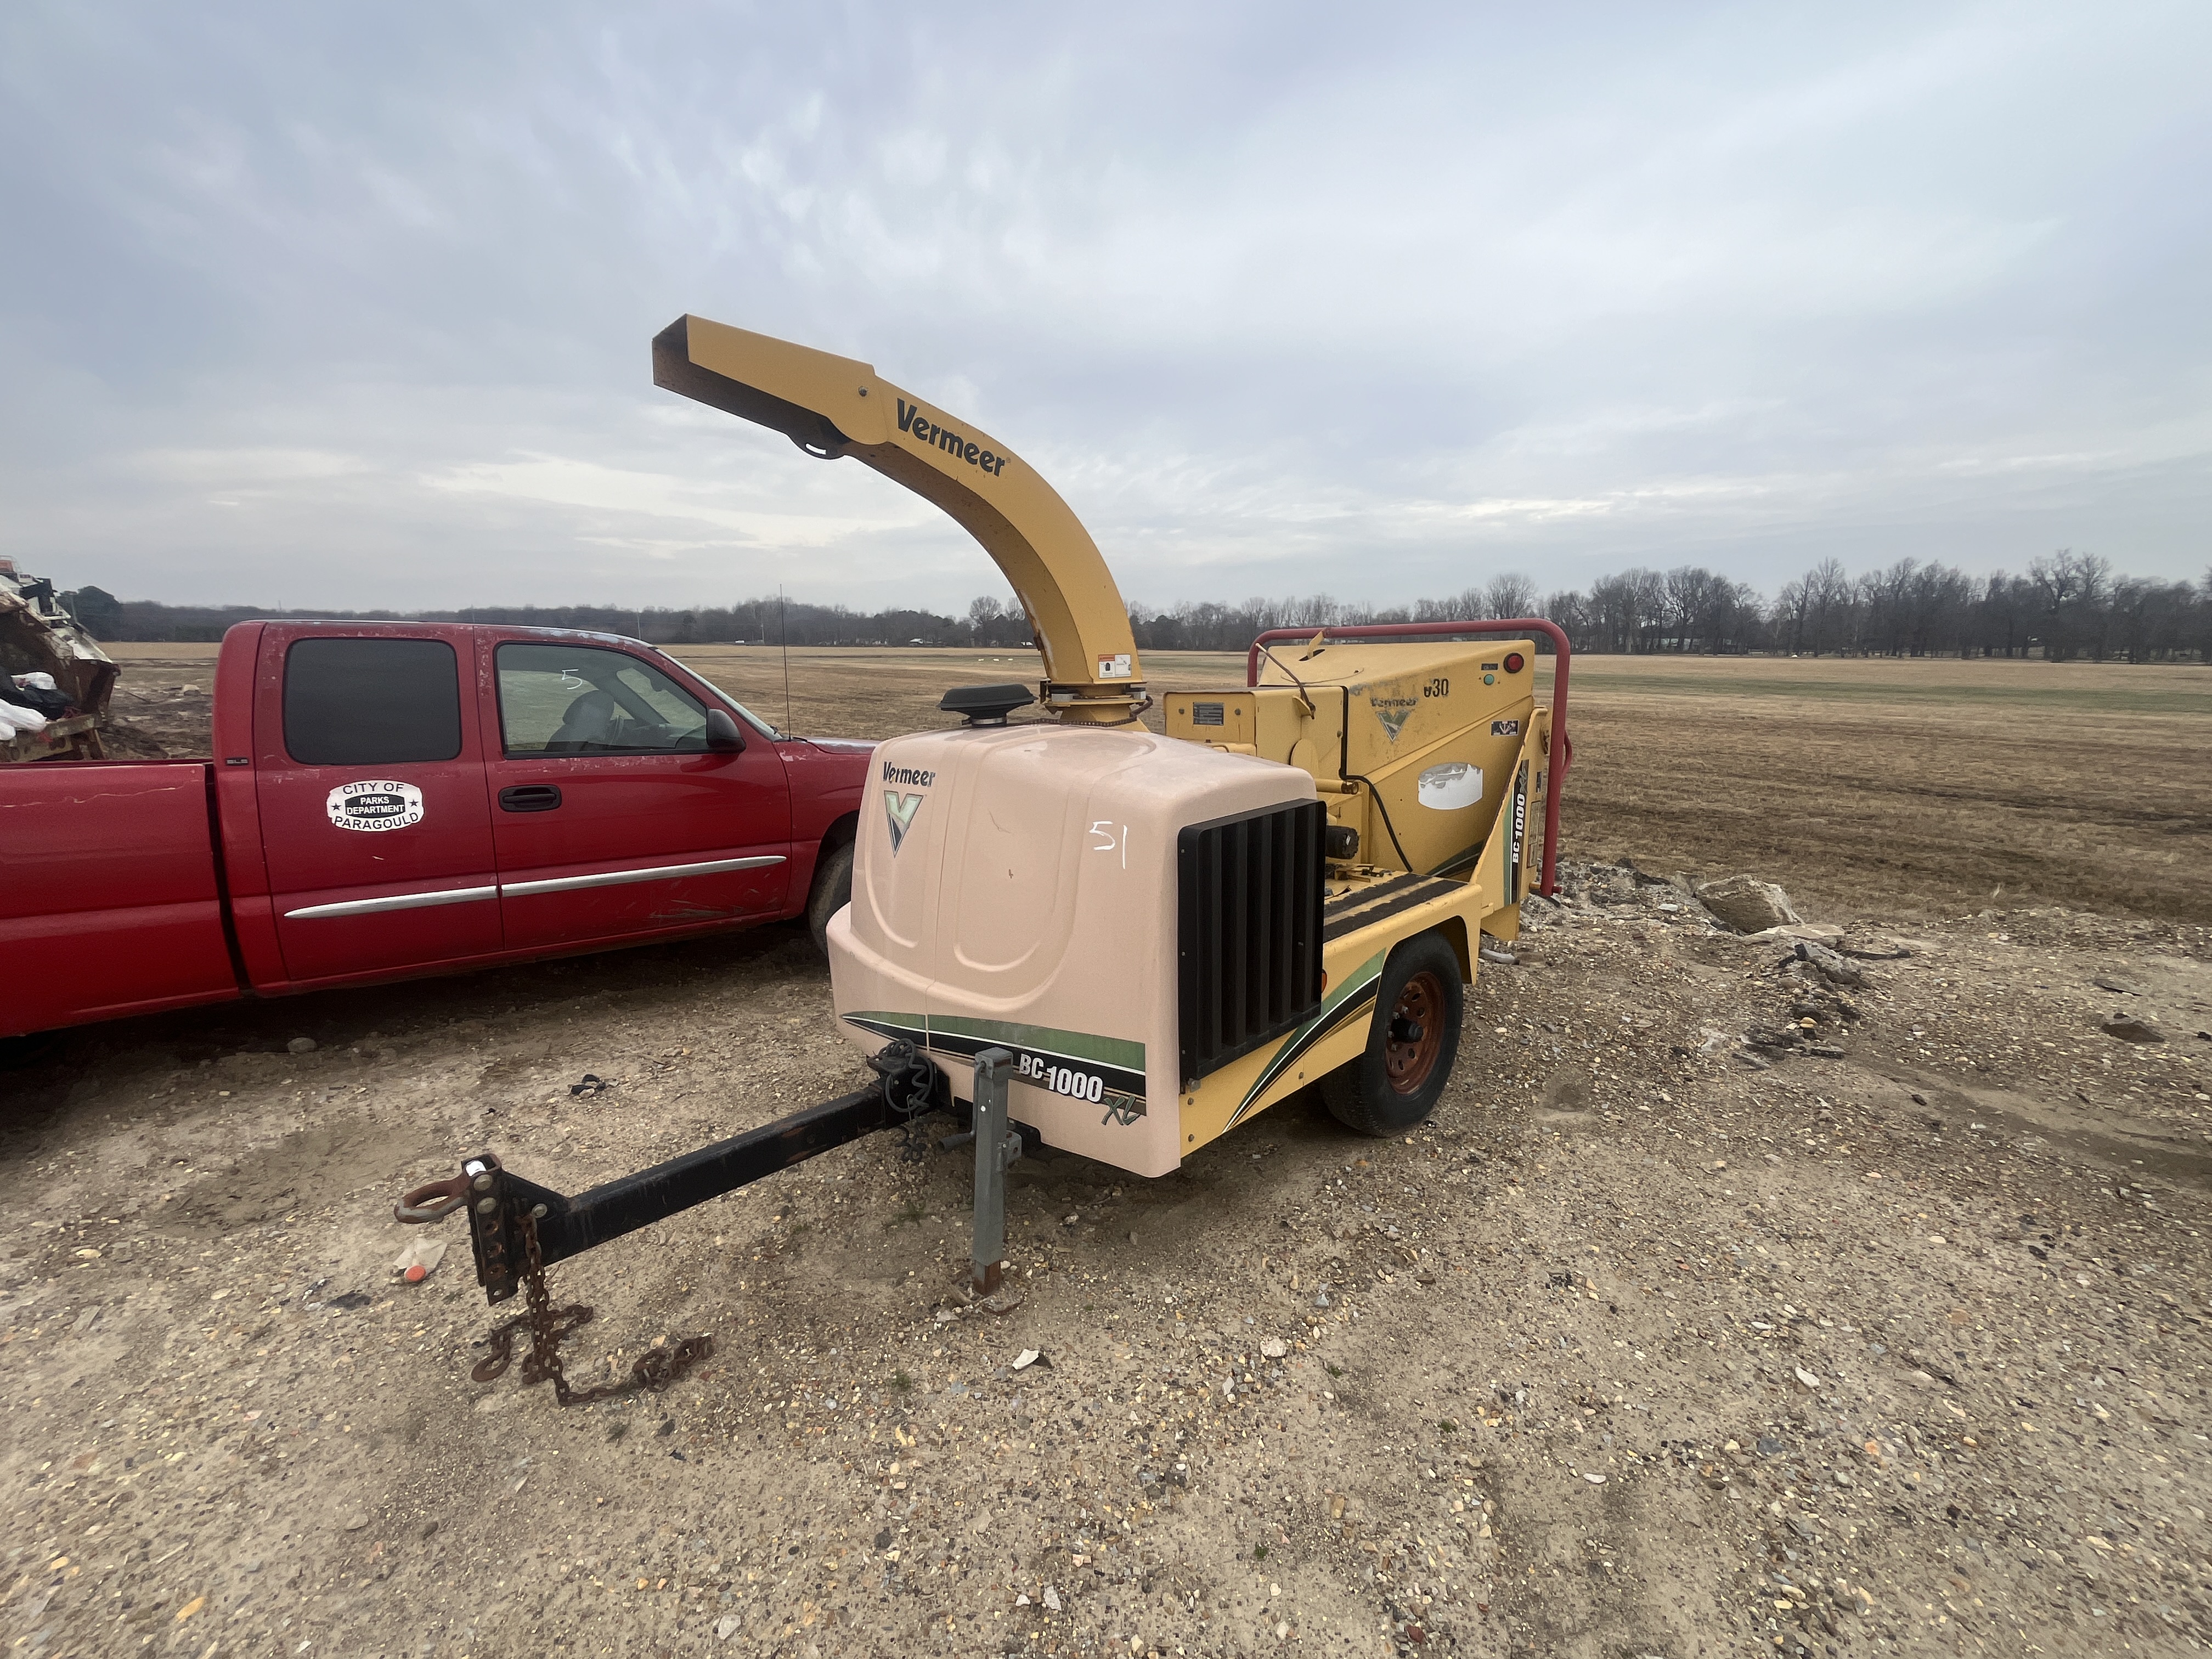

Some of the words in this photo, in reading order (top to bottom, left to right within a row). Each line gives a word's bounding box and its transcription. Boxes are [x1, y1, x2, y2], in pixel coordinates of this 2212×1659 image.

[897, 398, 1005, 477] Vermeer
[561, 669, 583, 690] 5
[883, 761, 936, 787] Vermeer
[343, 782, 377, 794] CITY
[383, 782, 404, 792] OF
[347, 804, 404, 815] DEPARTMENT
[360, 796, 390, 805] PARKS
[335, 812, 418, 830] PARAGOULD
[1515, 793, 1525, 839] 1000
[1089, 821, 1127, 869] 51
[1047, 1066, 1103, 1102] 1000
[1101, 1095, 1141, 1125] XL
